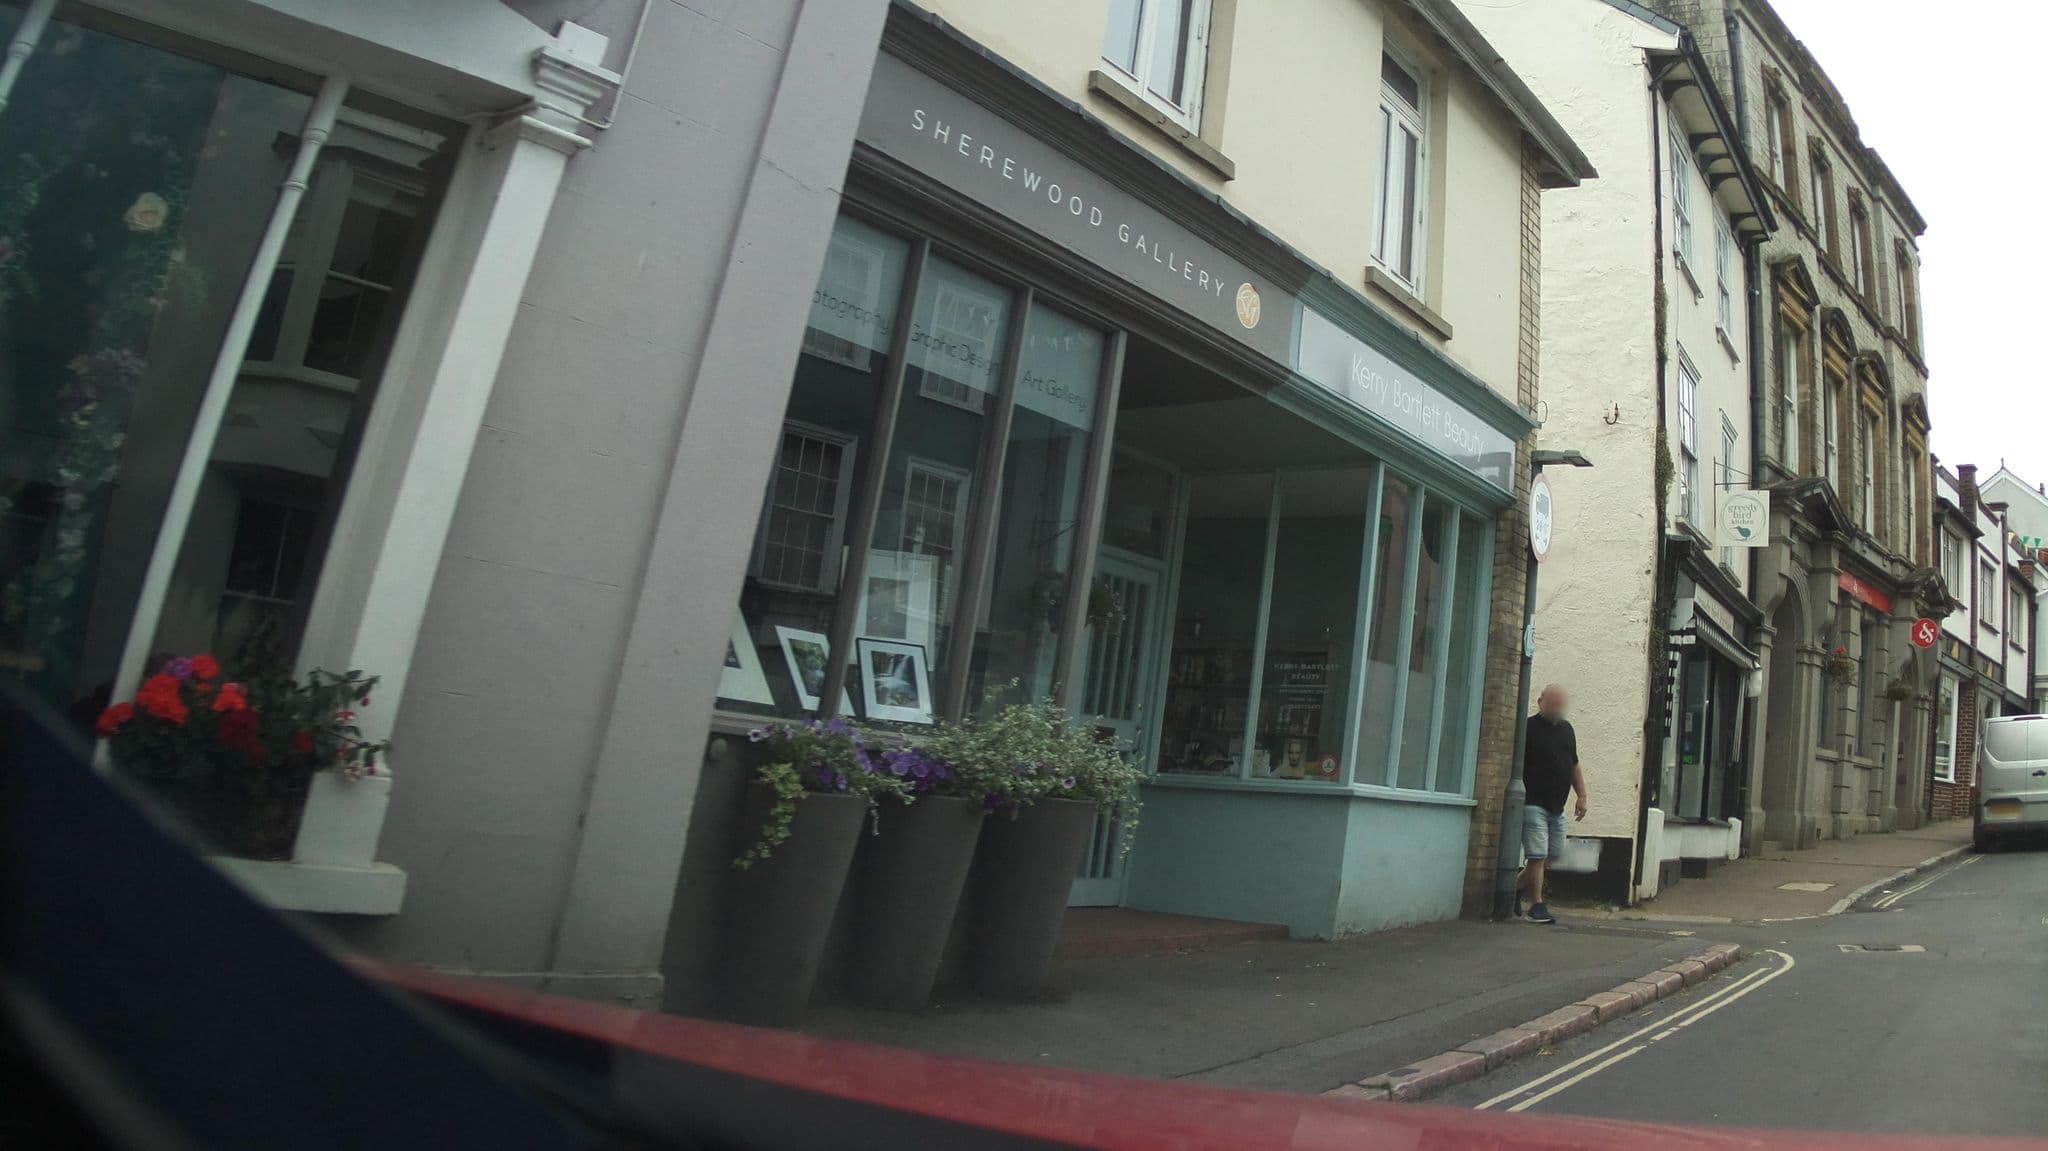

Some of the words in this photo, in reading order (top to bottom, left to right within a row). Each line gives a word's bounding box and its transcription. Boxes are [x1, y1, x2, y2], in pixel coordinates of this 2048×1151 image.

[911, 109, 1102, 226] SHEREWOOD
[1118, 224, 1225, 297] GALLERY
[813, 290, 889, 336] otography
[1020, 370, 1045, 391] Art
[1351, 352, 1389, 405] Kerry
[1393, 379, 1442, 429] Bartlett
[1444, 410, 1484, 462] Beauty
[1728, 504, 1757, 513] greedy
[1733, 511, 1752, 519] bird
